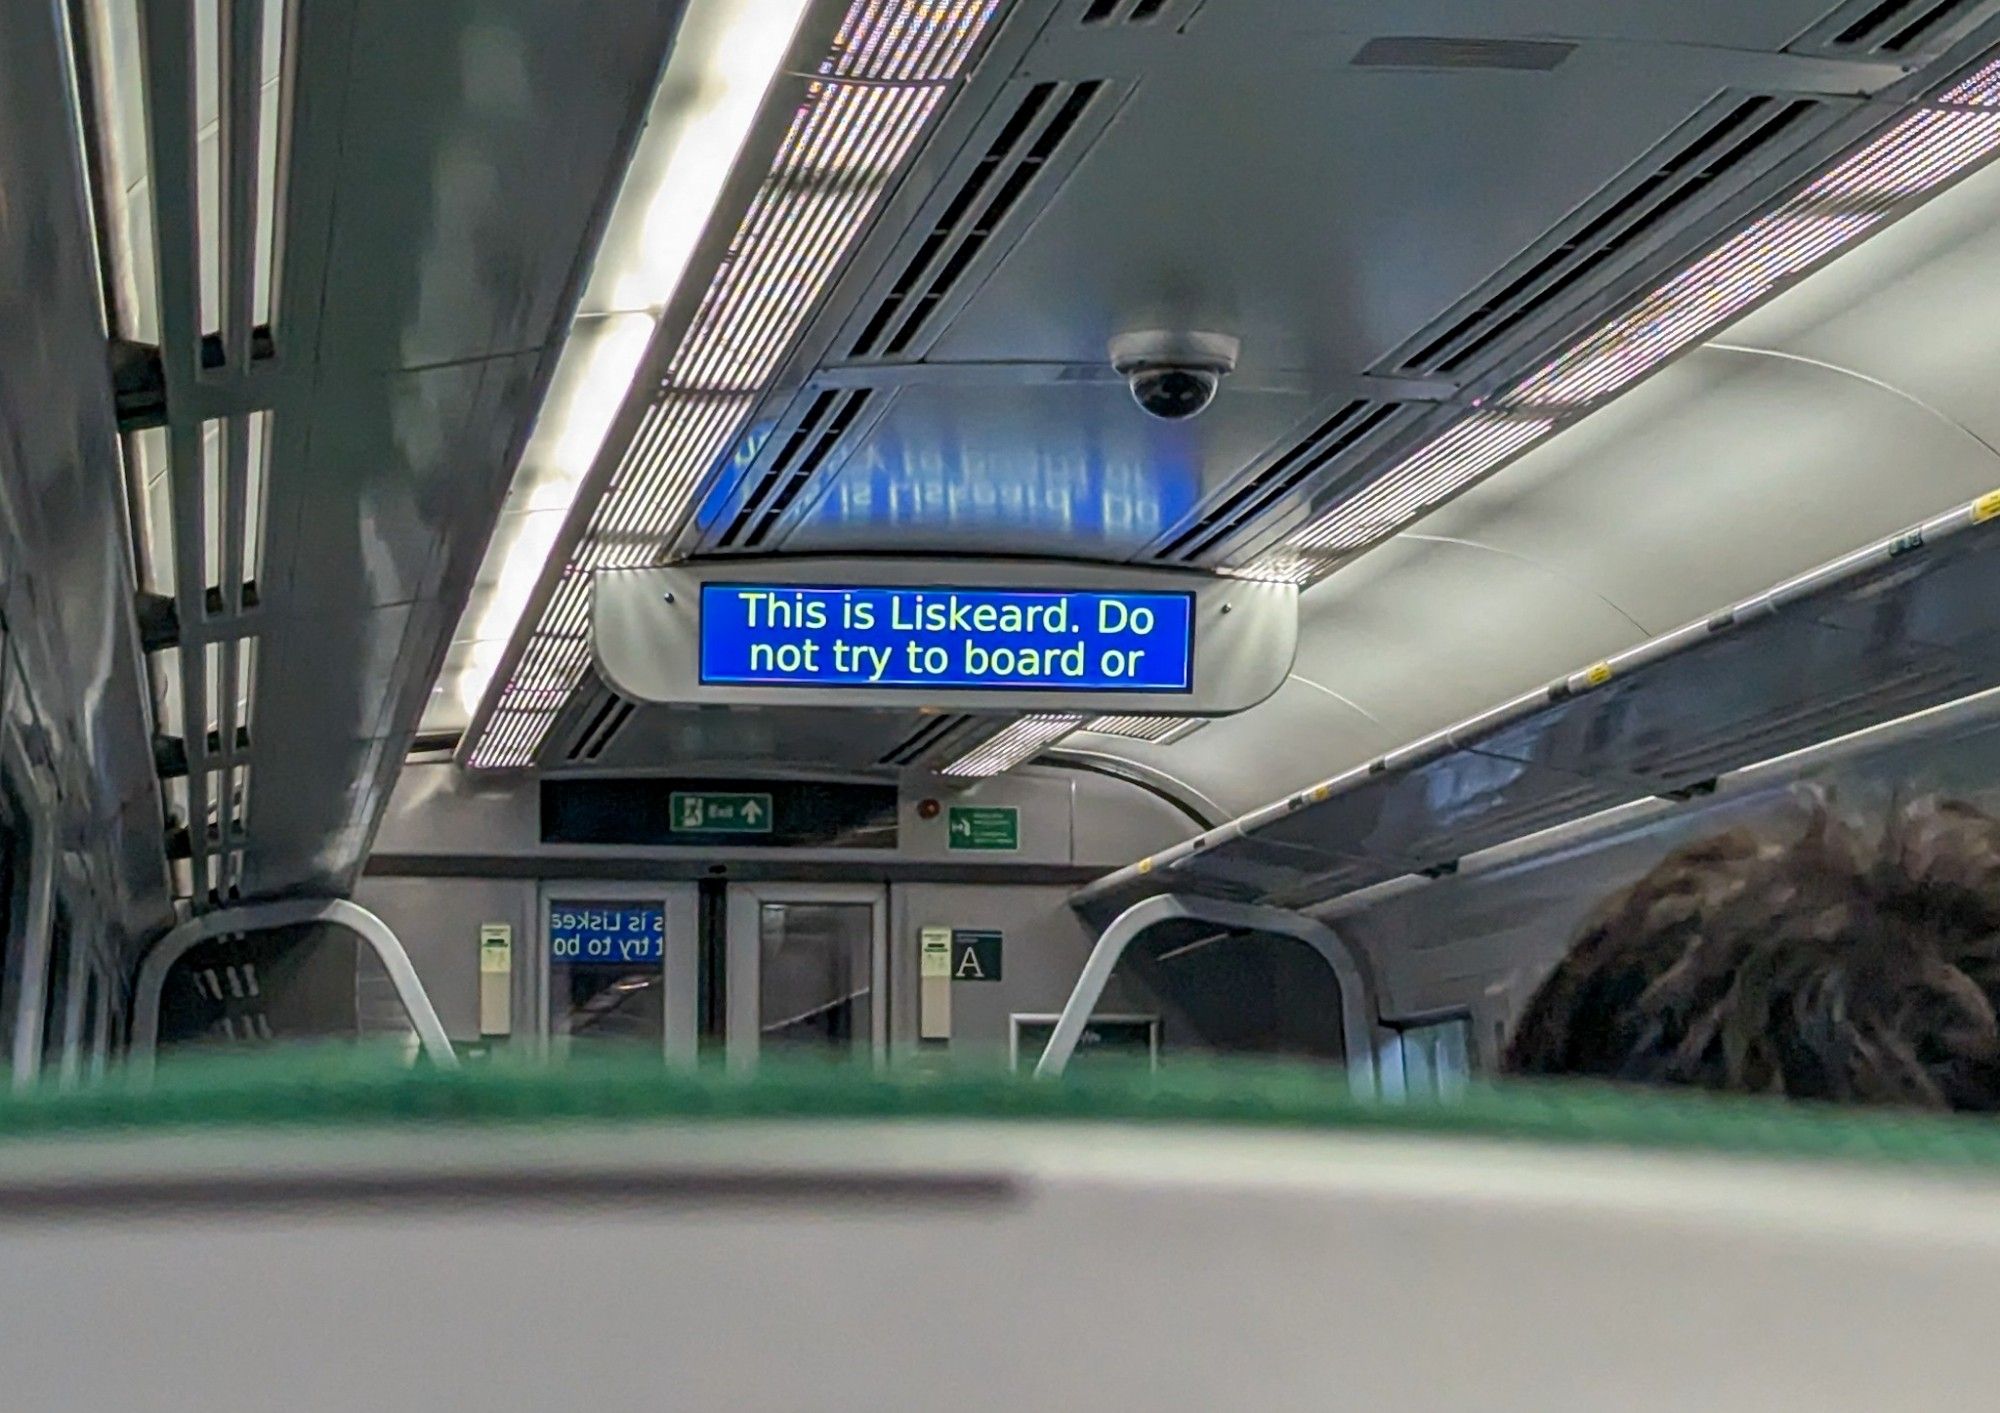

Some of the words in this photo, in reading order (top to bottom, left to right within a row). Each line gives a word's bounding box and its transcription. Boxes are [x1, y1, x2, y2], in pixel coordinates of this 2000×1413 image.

[739, 592, 826, 628] This
[844, 594, 874, 629] is
[892, 595, 1078, 633] Liskeard.
[1099, 600, 1154, 634] Do
[751, 639, 819, 671] not
[833, 639, 892, 680] try
[907, 641, 948, 674] to
[966, 639, 1084, 676] board
[1101, 650, 1144, 677] or
[955, 946, 984, 978] A
